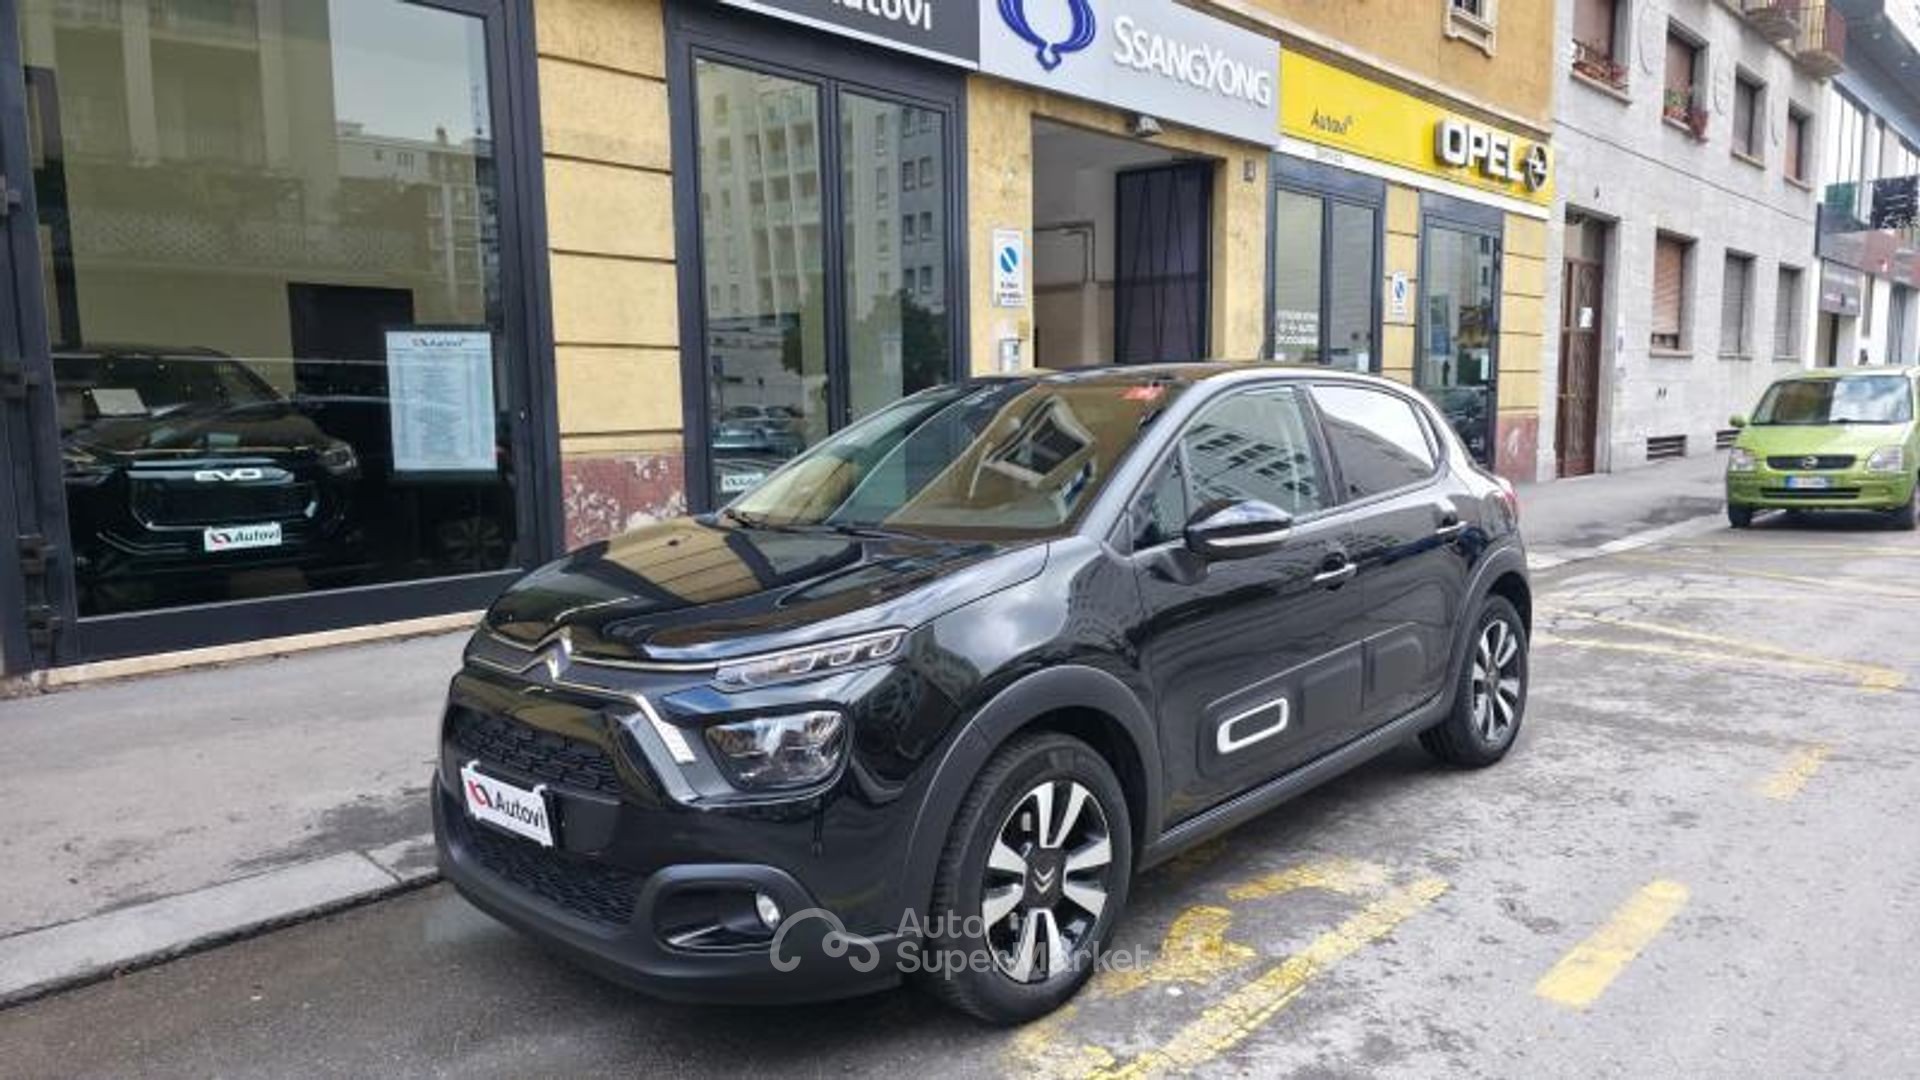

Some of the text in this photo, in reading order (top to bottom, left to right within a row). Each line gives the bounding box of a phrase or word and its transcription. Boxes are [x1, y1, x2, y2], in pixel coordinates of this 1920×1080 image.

[1113, 15, 1270, 107] SSANGYONG
[1435, 118, 1525, 181] OPEL
[194, 468, 262, 481] EVO
[496, 791, 546, 829] Autovi
